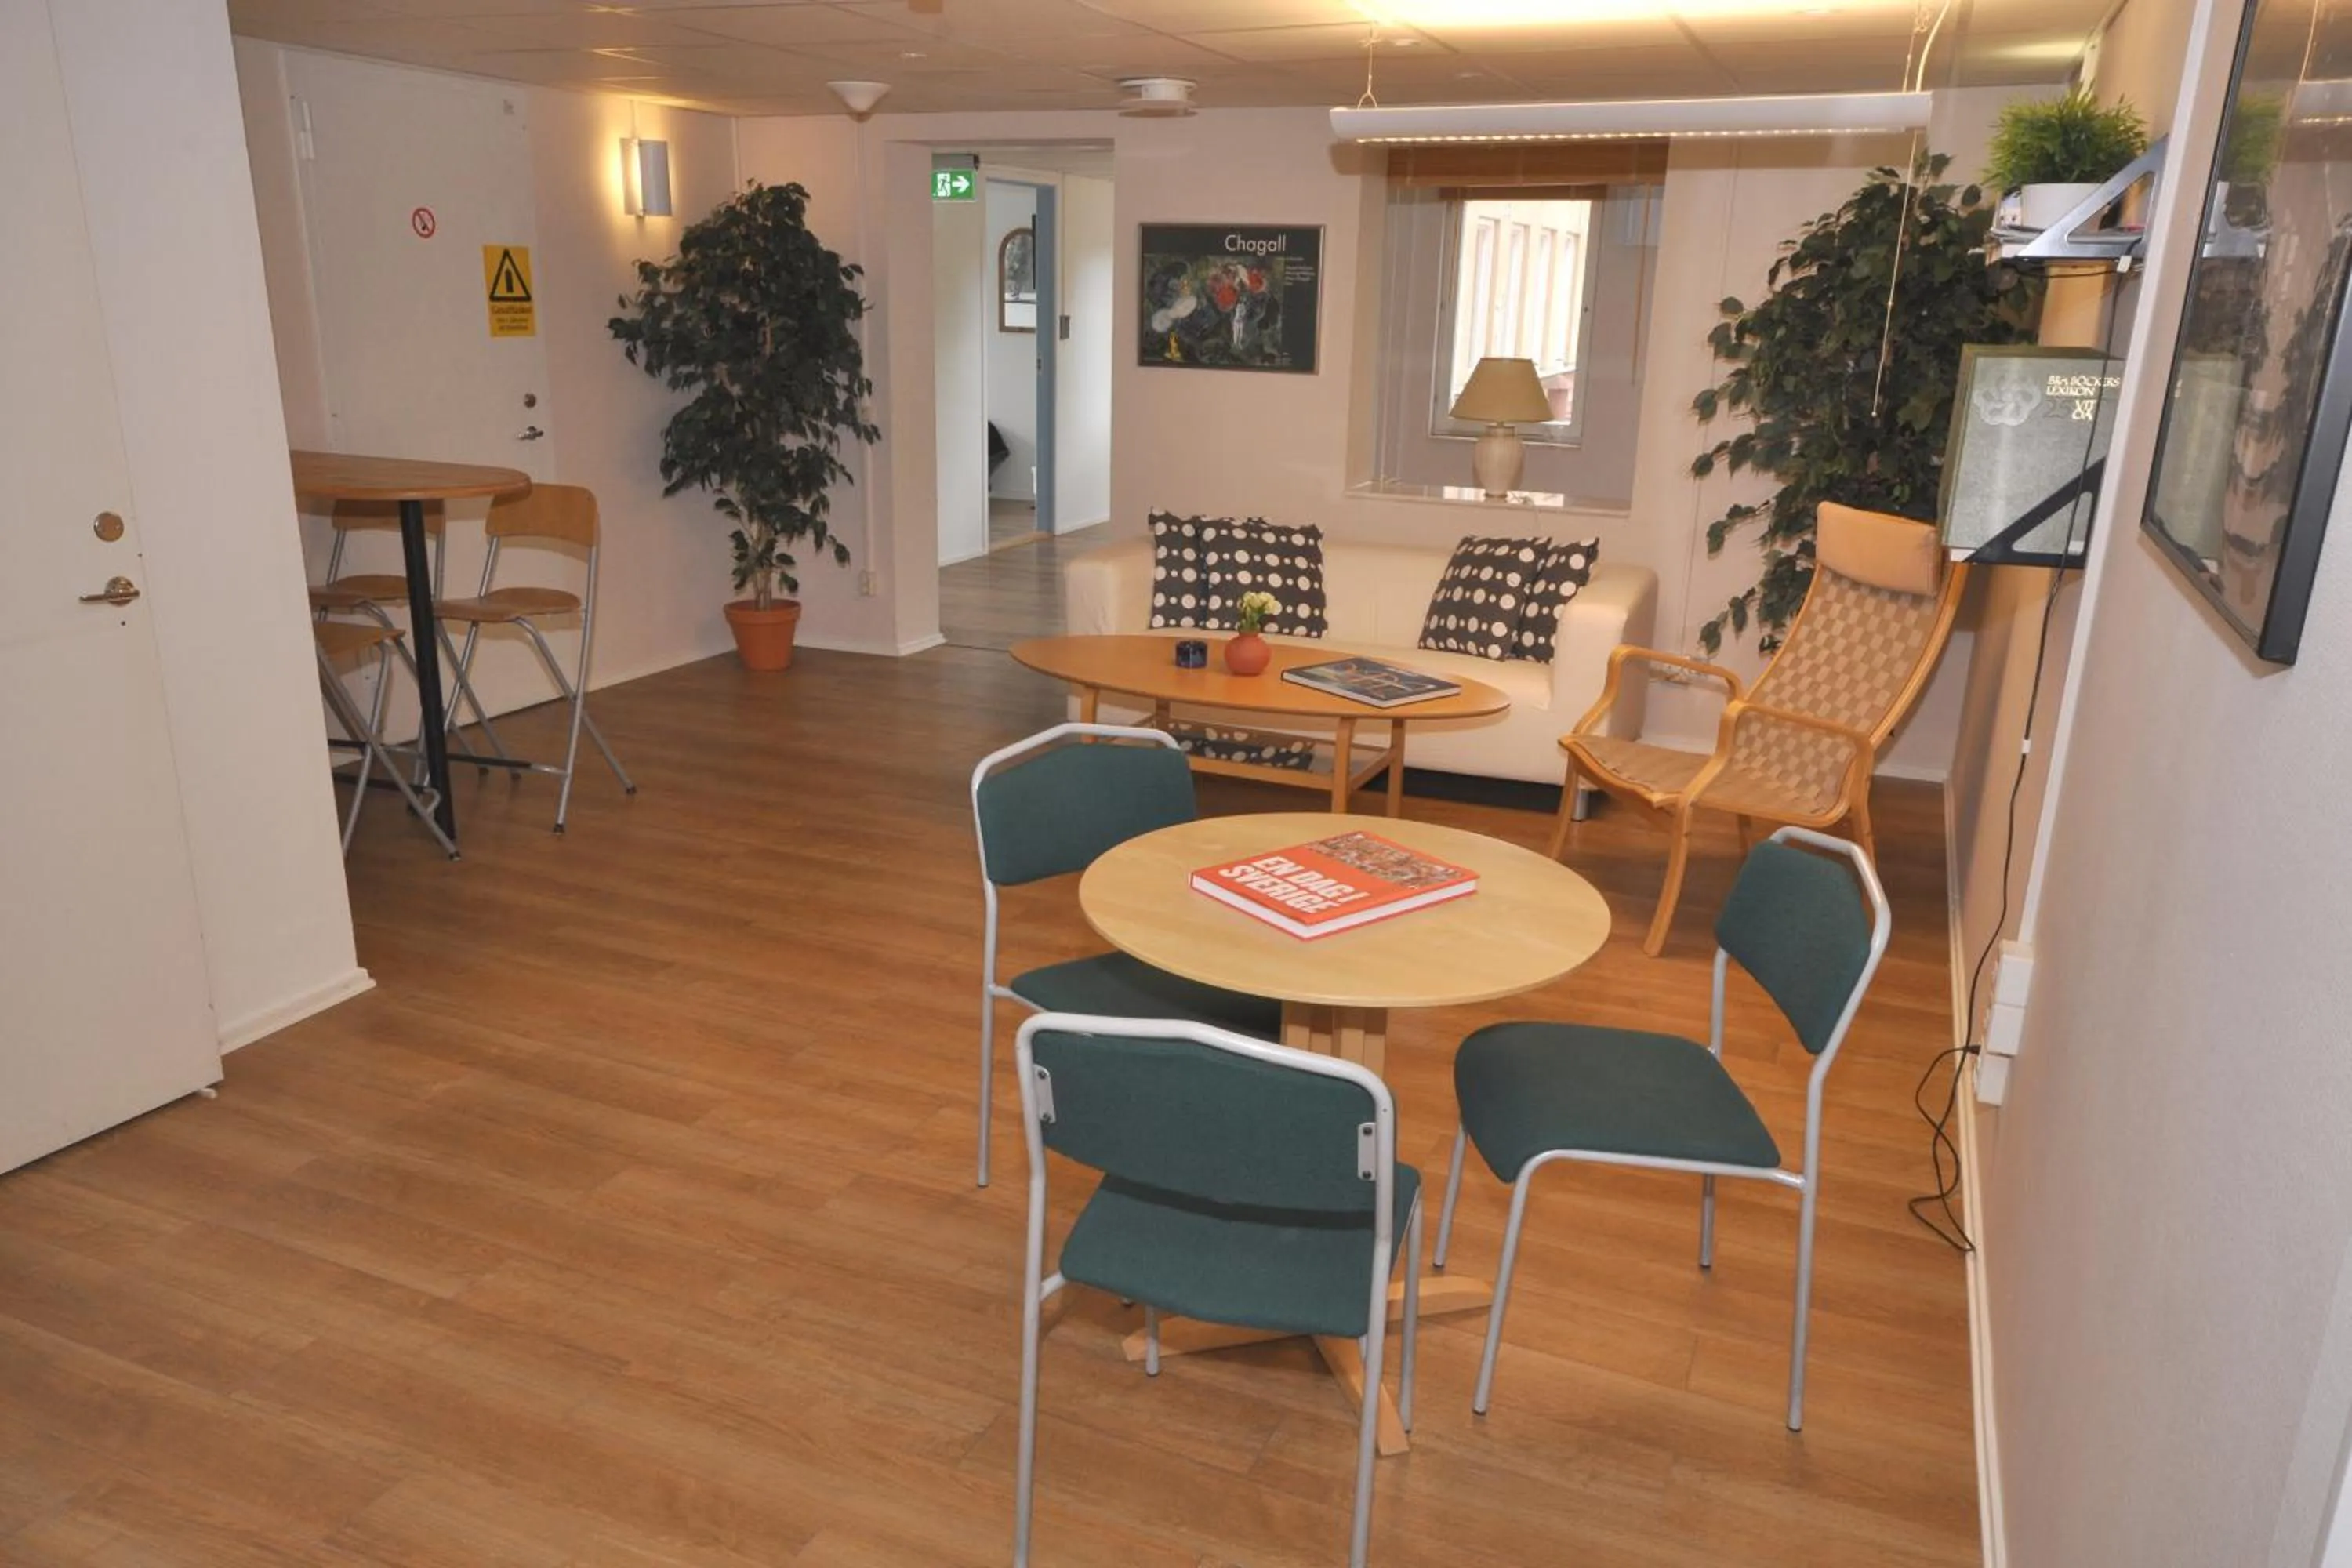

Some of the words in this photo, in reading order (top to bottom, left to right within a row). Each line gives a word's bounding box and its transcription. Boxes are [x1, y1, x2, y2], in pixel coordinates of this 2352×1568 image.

[1225, 234, 1287, 256] Chagall
[1218, 865, 1341, 914] SVERIGE
[1251, 856, 1305, 877] EN
[1284, 870, 1356, 899] DAG
